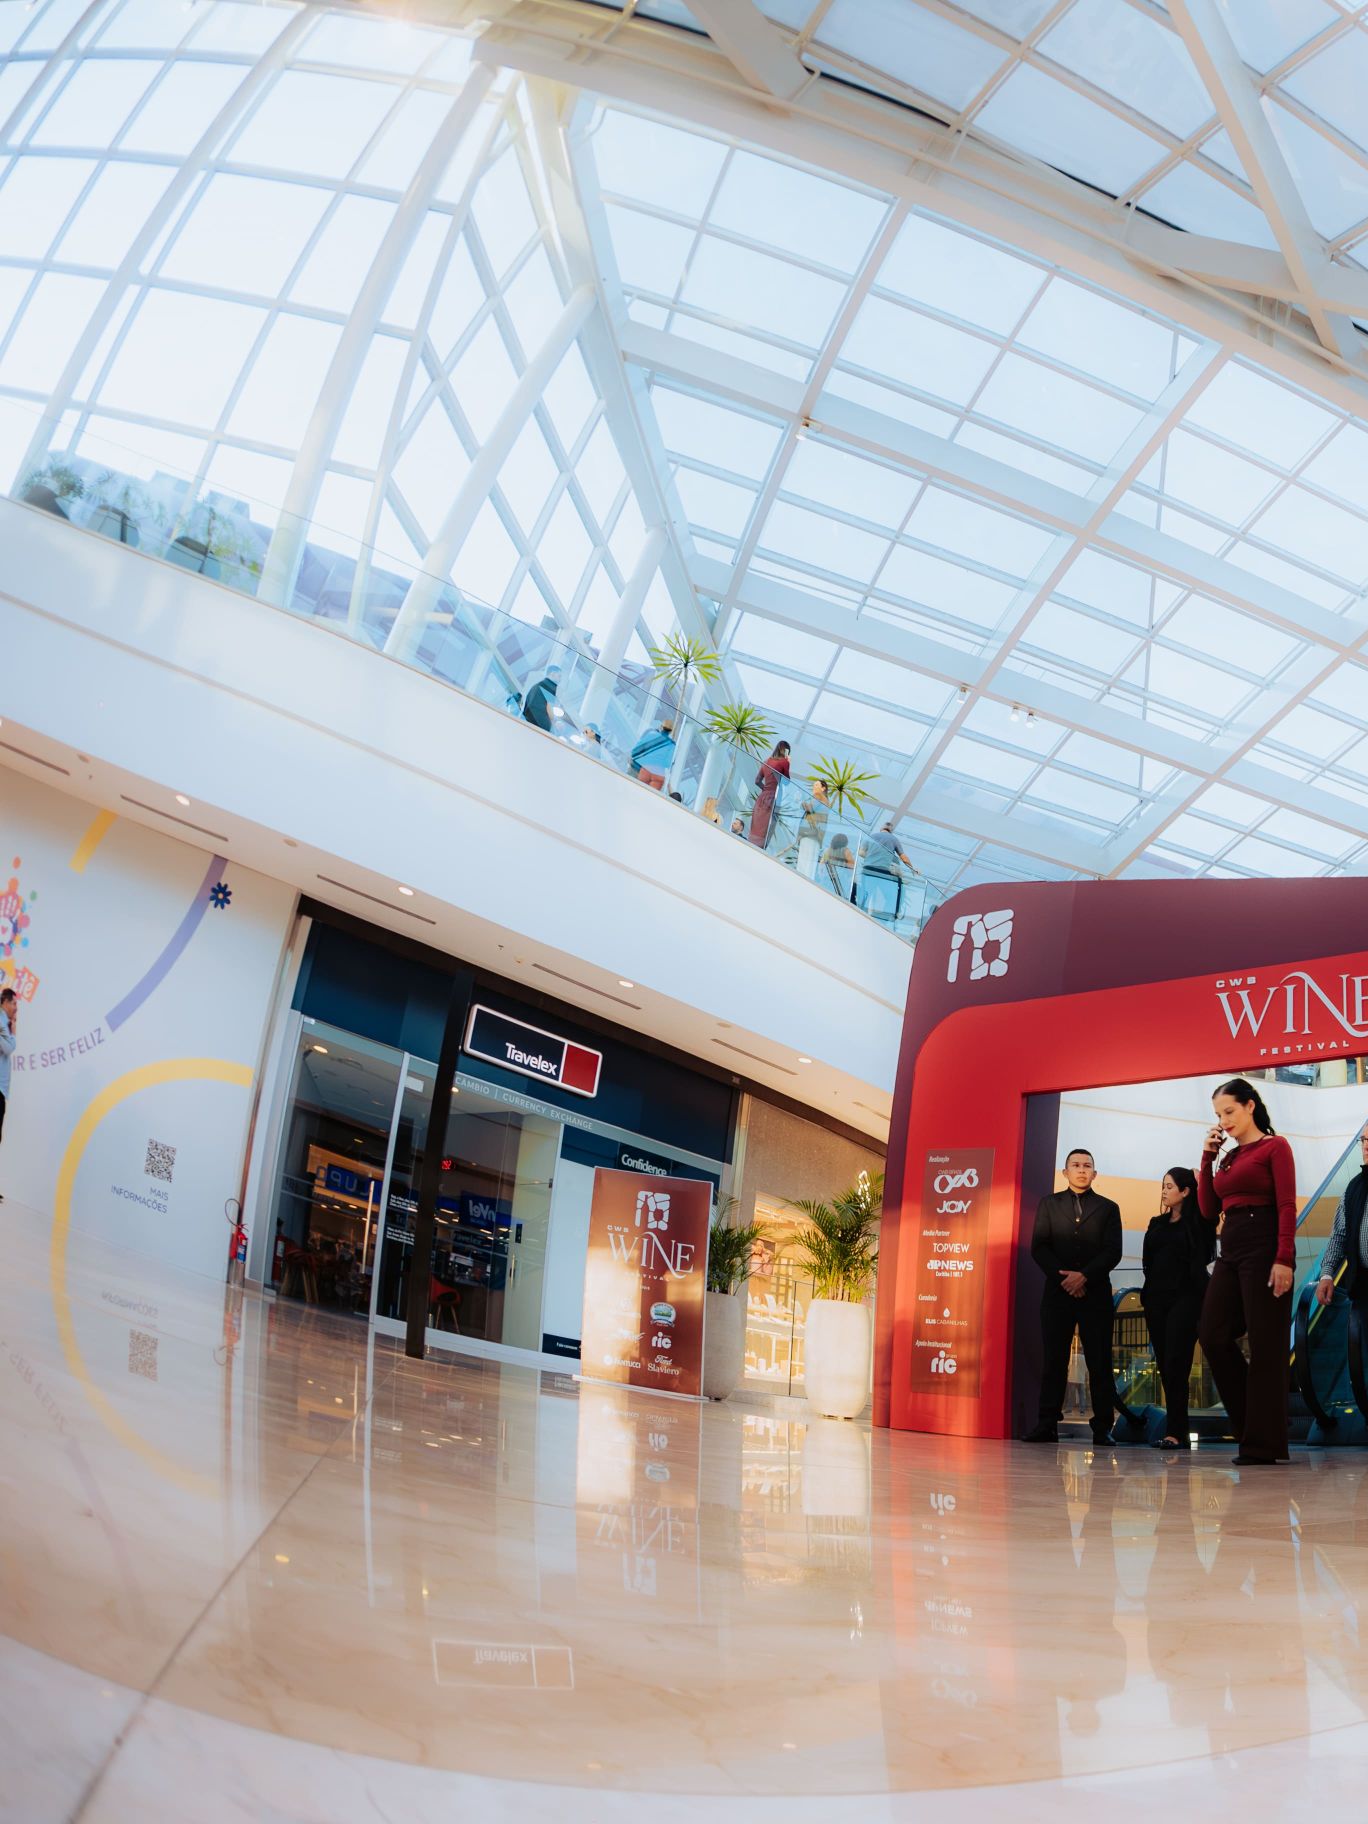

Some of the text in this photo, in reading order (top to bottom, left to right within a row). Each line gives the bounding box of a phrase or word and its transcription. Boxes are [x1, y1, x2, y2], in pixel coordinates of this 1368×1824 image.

[1215, 976, 1257, 988] CWB
[40, 1046, 67, 1069] SER
[69, 1027, 105, 1054] FELIZ
[505, 1042, 558, 1077] Travelex
[1260, 1040, 1350, 1056] FESTIVAL
[502, 1092, 547, 1114] CURRENCY
[550, 1108, 593, 1130] EXCHANGE
[620, 1153, 668, 1177] Confidence
[111, 1185, 168, 1214] INFORMAÇÕES
[150, 1187, 169, 1201] MAIS
[607, 1231, 695, 1279] WINE
[933, 1243, 970, 1254] TOPVIEW
[651, 1331, 672, 1349] ric
[647, 1363, 680, 1375] Slaviero
[930, 1350, 957, 1375] ric
